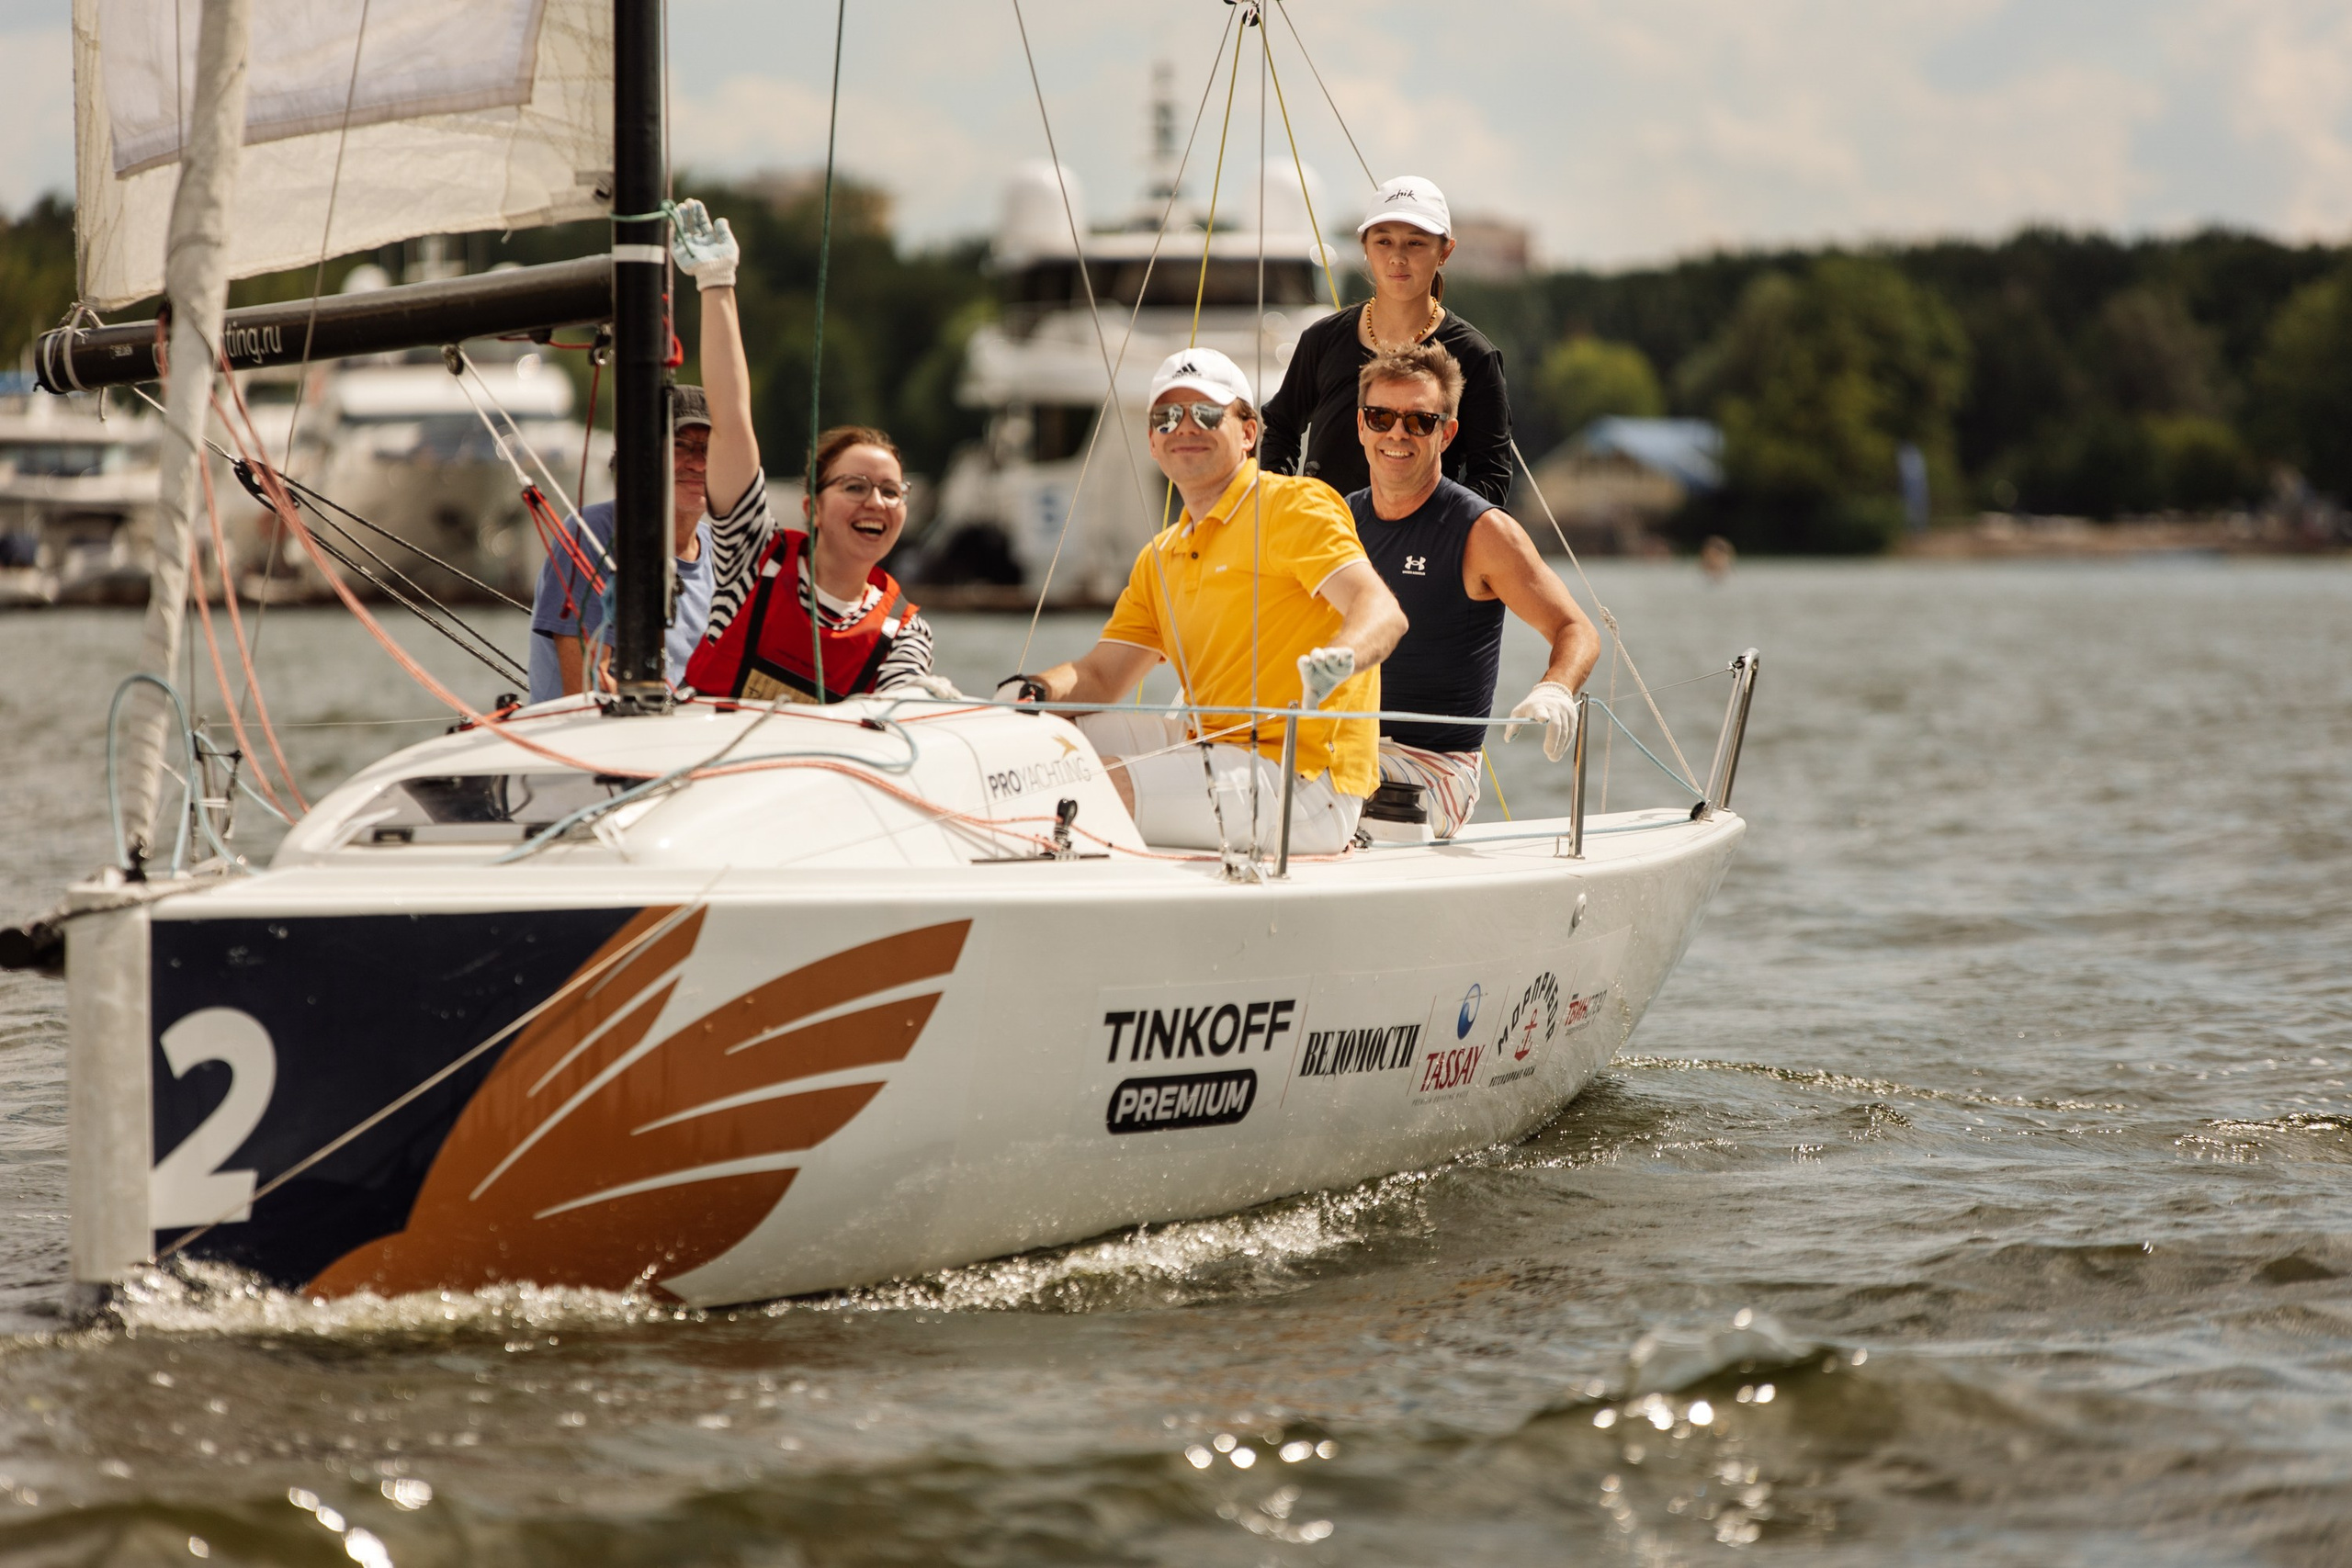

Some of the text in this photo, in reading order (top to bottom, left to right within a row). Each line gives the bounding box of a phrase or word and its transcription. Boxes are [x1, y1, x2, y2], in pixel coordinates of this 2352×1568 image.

[1385, 188, 1418, 203] zhik
[223, 321, 283, 364] ting.ru
[988, 757, 1091, 798] PROYACHTING
[1104, 999, 1295, 1064] TINKOFF
[1298, 1024, 1421, 1082] ВЕДОМОСТИ
[1419, 1044, 1486, 1092] TASSAY
[150, 1007, 277, 1231] 2
[1114, 1077, 1251, 1124] PREMIUM
